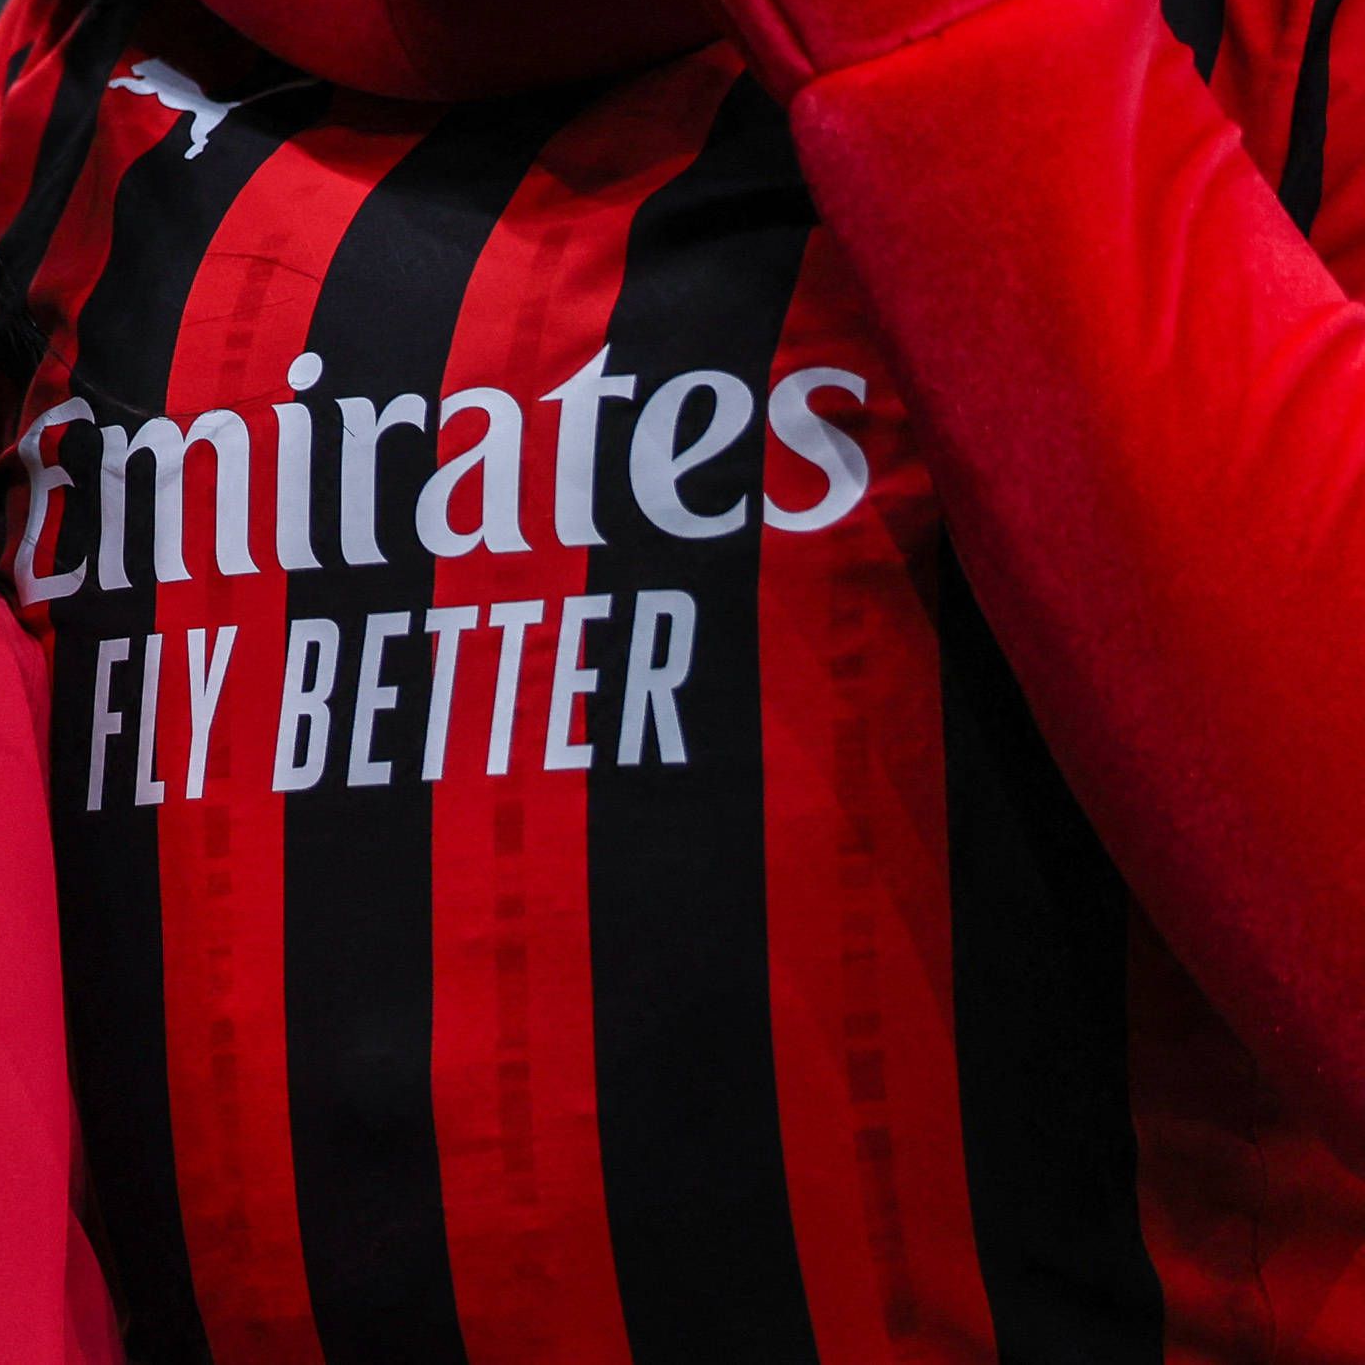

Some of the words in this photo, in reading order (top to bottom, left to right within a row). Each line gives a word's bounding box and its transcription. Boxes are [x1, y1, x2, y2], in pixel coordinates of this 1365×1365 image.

[15, 343, 869, 606] Emirates
[86, 625, 238, 811] FLY
[271, 589, 696, 792] BETTER
